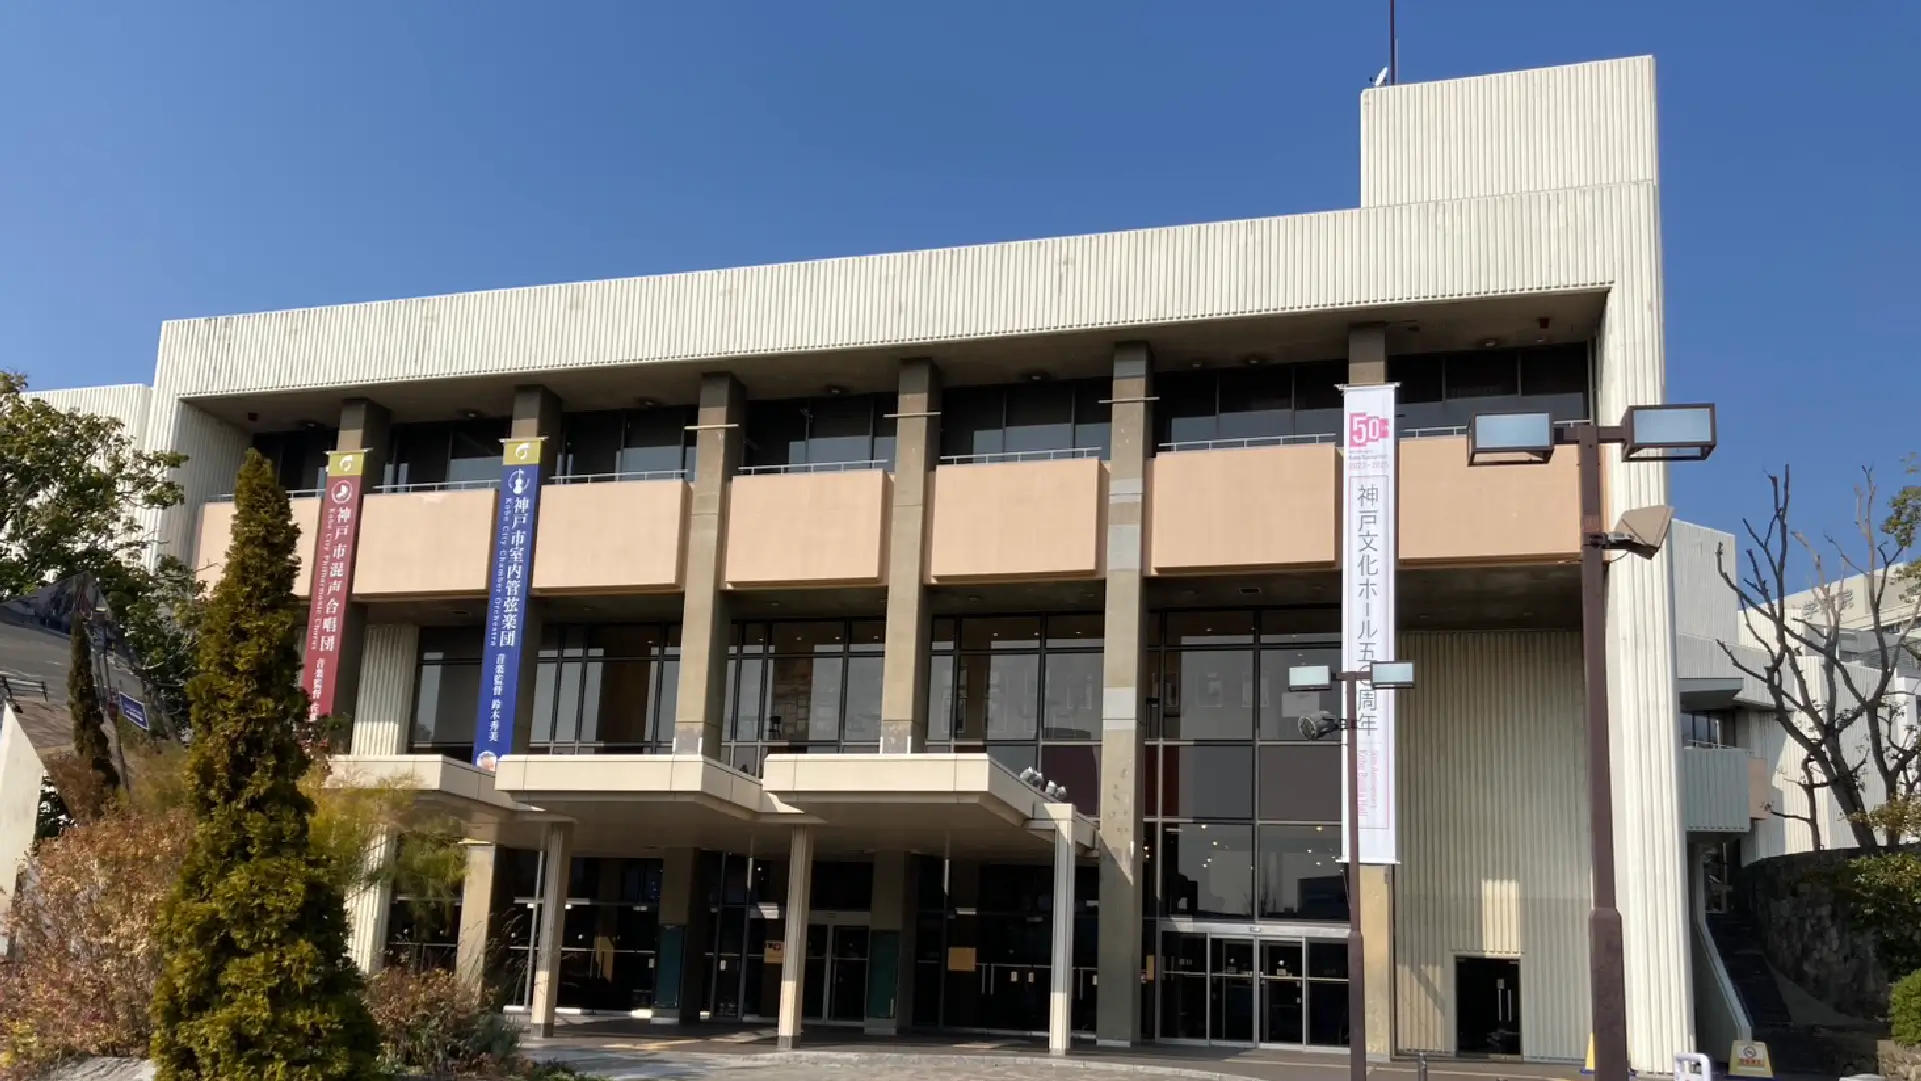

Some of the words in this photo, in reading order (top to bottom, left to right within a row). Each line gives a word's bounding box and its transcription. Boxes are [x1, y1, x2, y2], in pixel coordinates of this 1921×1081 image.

[319, 506, 352, 652] 神戸市混声合唱団
[499, 497, 529, 647] 神戸市室内管弦楽団
